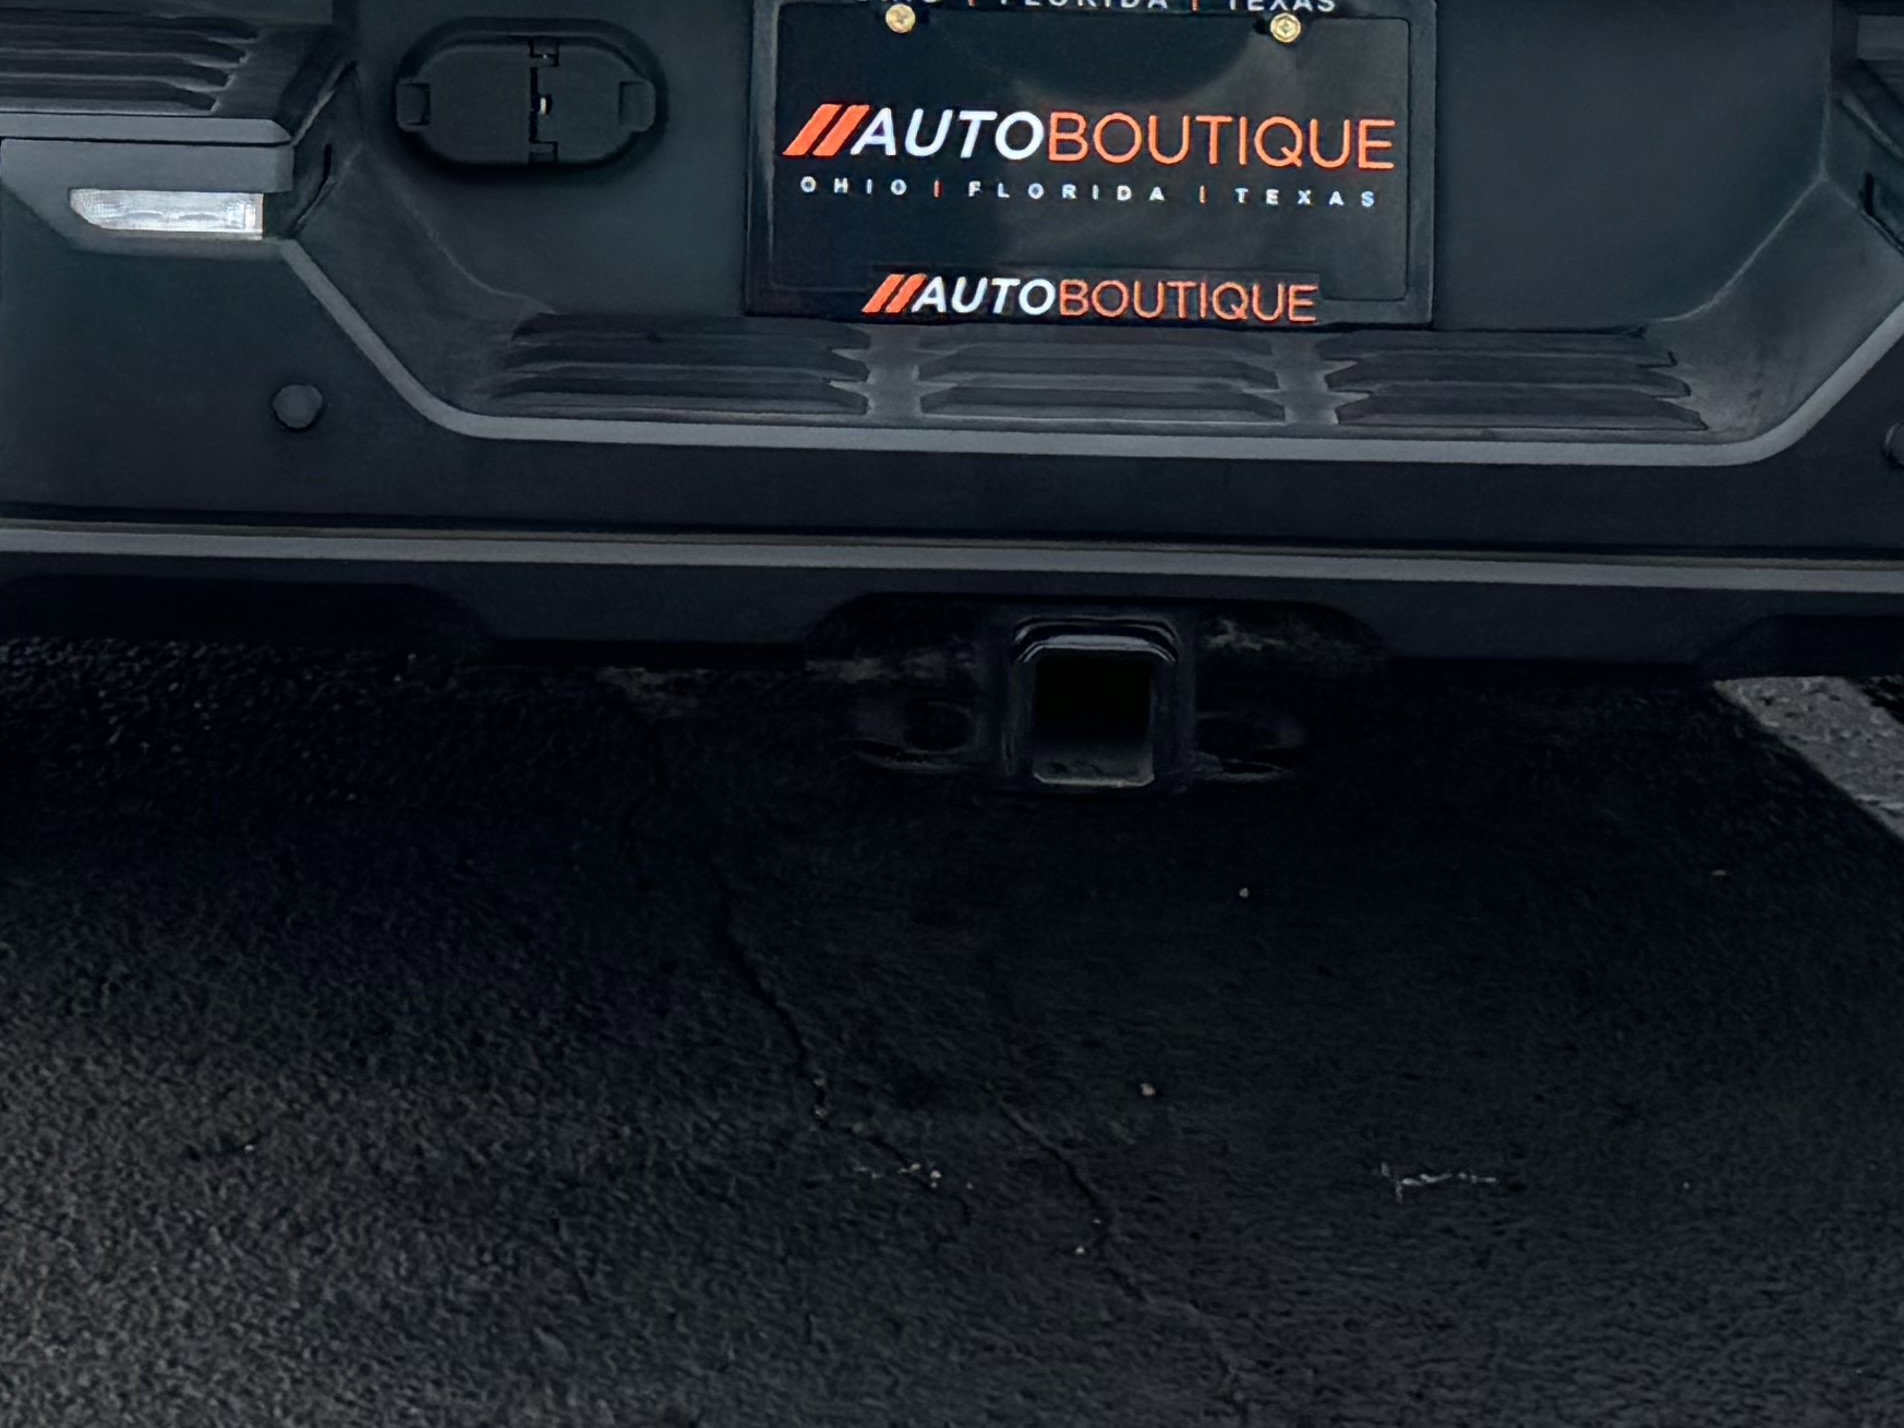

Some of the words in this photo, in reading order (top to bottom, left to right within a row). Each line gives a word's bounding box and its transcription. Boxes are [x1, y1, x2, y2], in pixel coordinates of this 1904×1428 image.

[851, 107, 1396, 170] AUTOBOUTIQUE
[800, 176, 907, 196] OHIO
[968, 180, 1165, 202] FLORIDA
[1235, 187, 1376, 208] TEXAS
[911, 277, 1319, 324] AUTOBOUTIQUE
